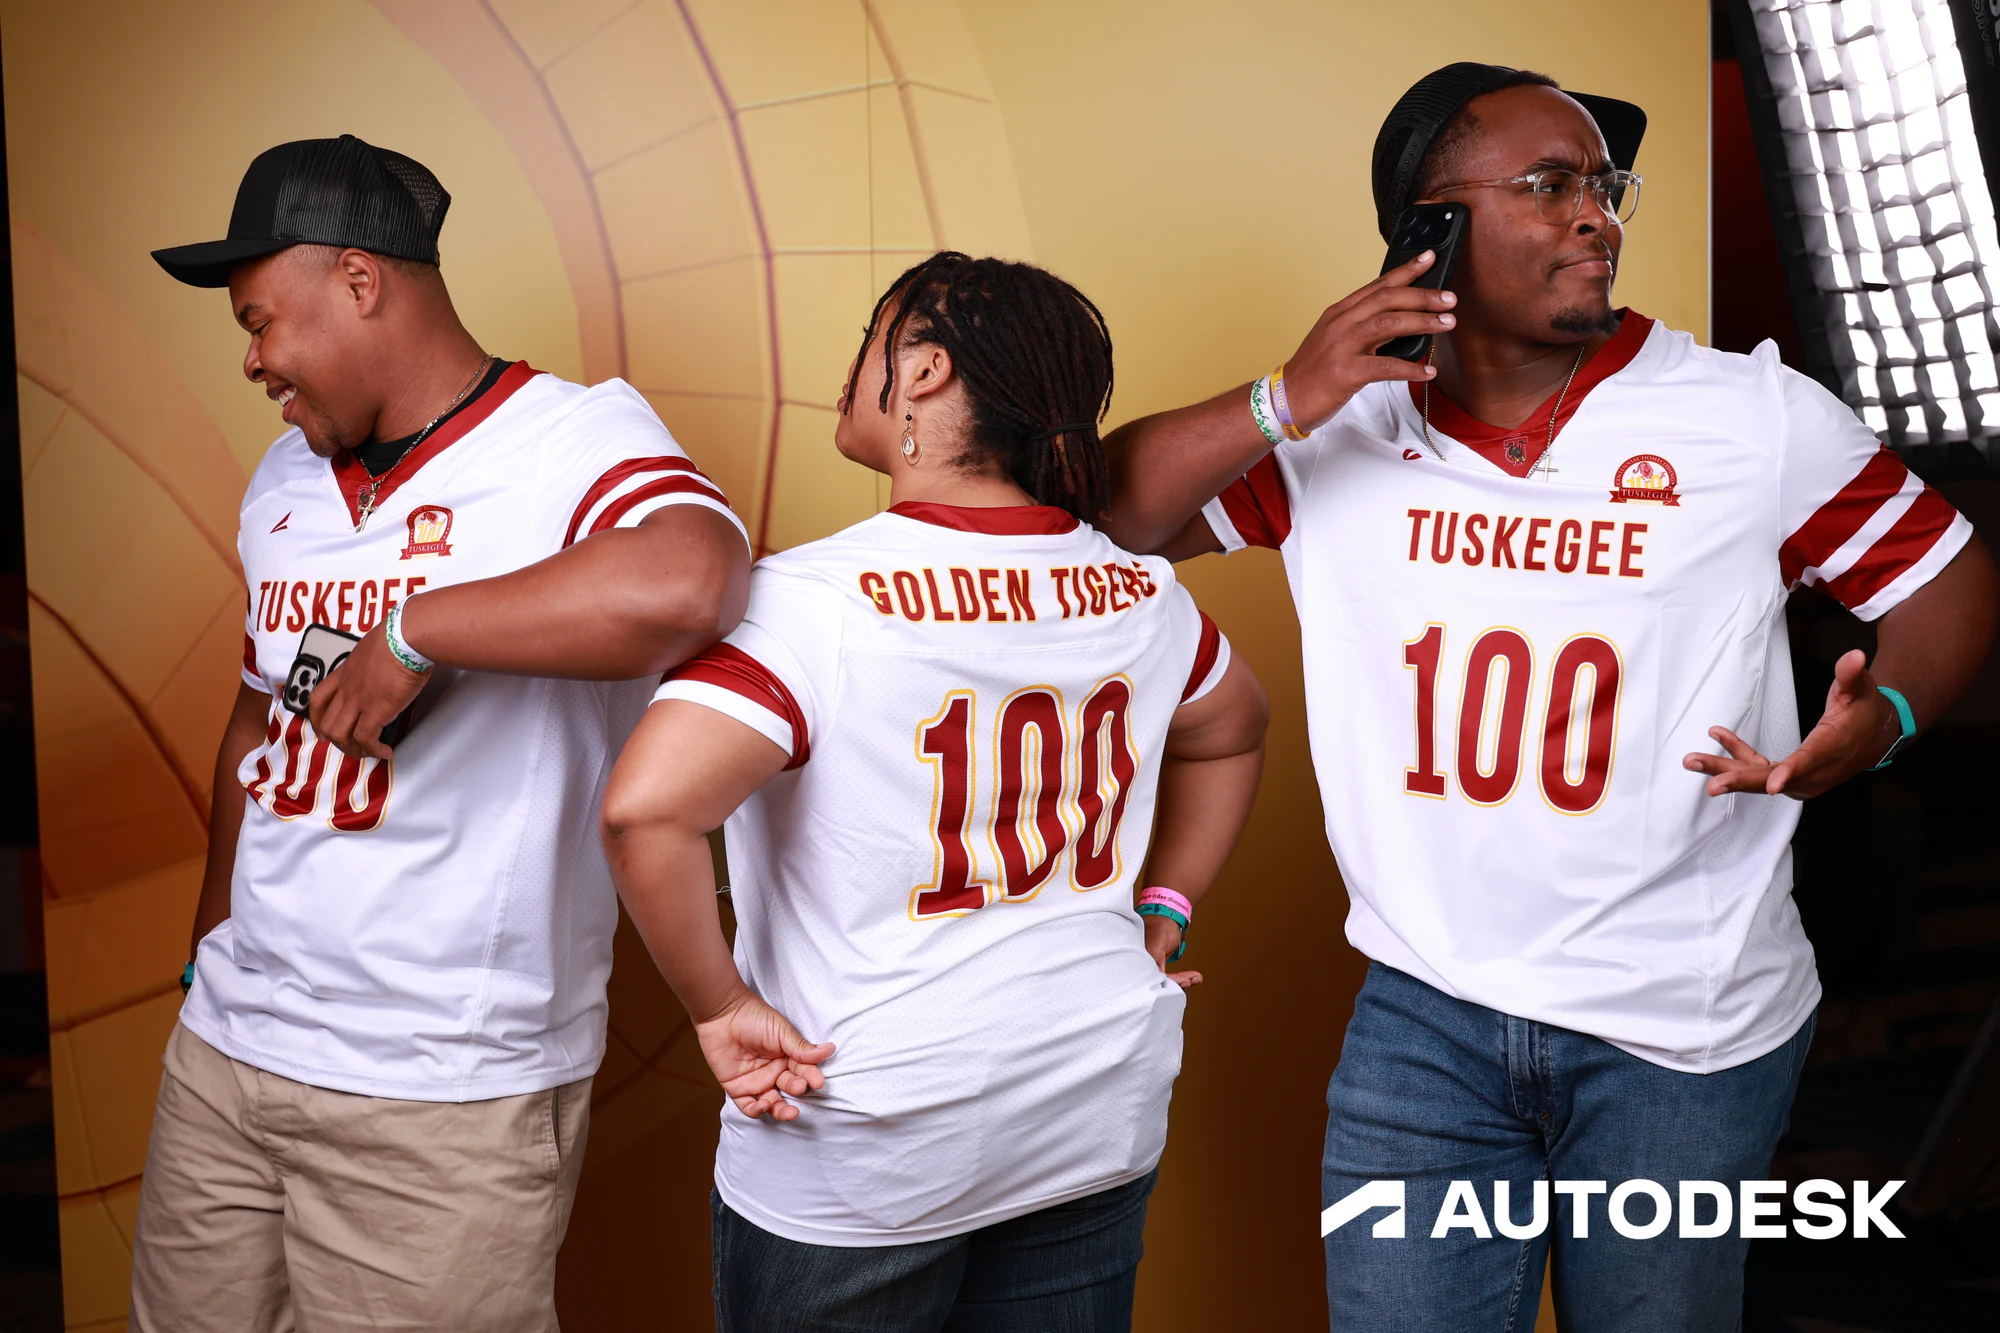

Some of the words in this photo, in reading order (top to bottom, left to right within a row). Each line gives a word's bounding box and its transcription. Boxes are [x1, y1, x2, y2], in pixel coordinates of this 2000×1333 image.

[1621, 489, 1670, 500] TUSKEGEE
[409, 543, 445, 553] TUSKEGEE
[1406, 508, 1649, 578] TUSKEGEE
[858, 567, 1036, 624] GOLDEN
[1402, 621, 1625, 817] 100
[908, 672, 1140, 921] 100
